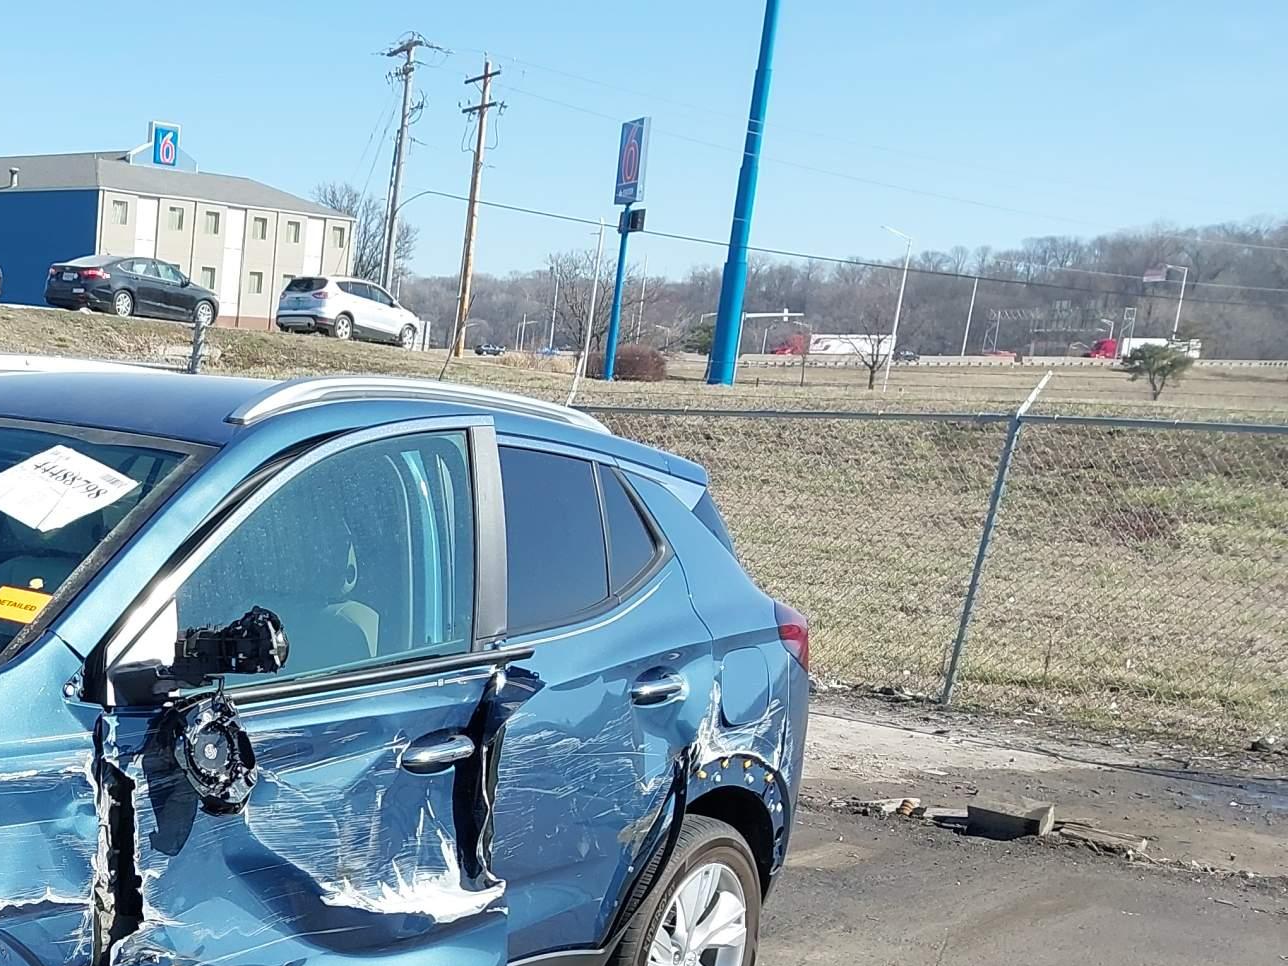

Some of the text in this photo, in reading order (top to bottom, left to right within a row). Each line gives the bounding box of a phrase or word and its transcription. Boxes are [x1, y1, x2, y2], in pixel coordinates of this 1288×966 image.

[159, 131, 175, 165] 6
[622, 123, 640, 184] 6
[33, 460, 108, 500] 44488798
